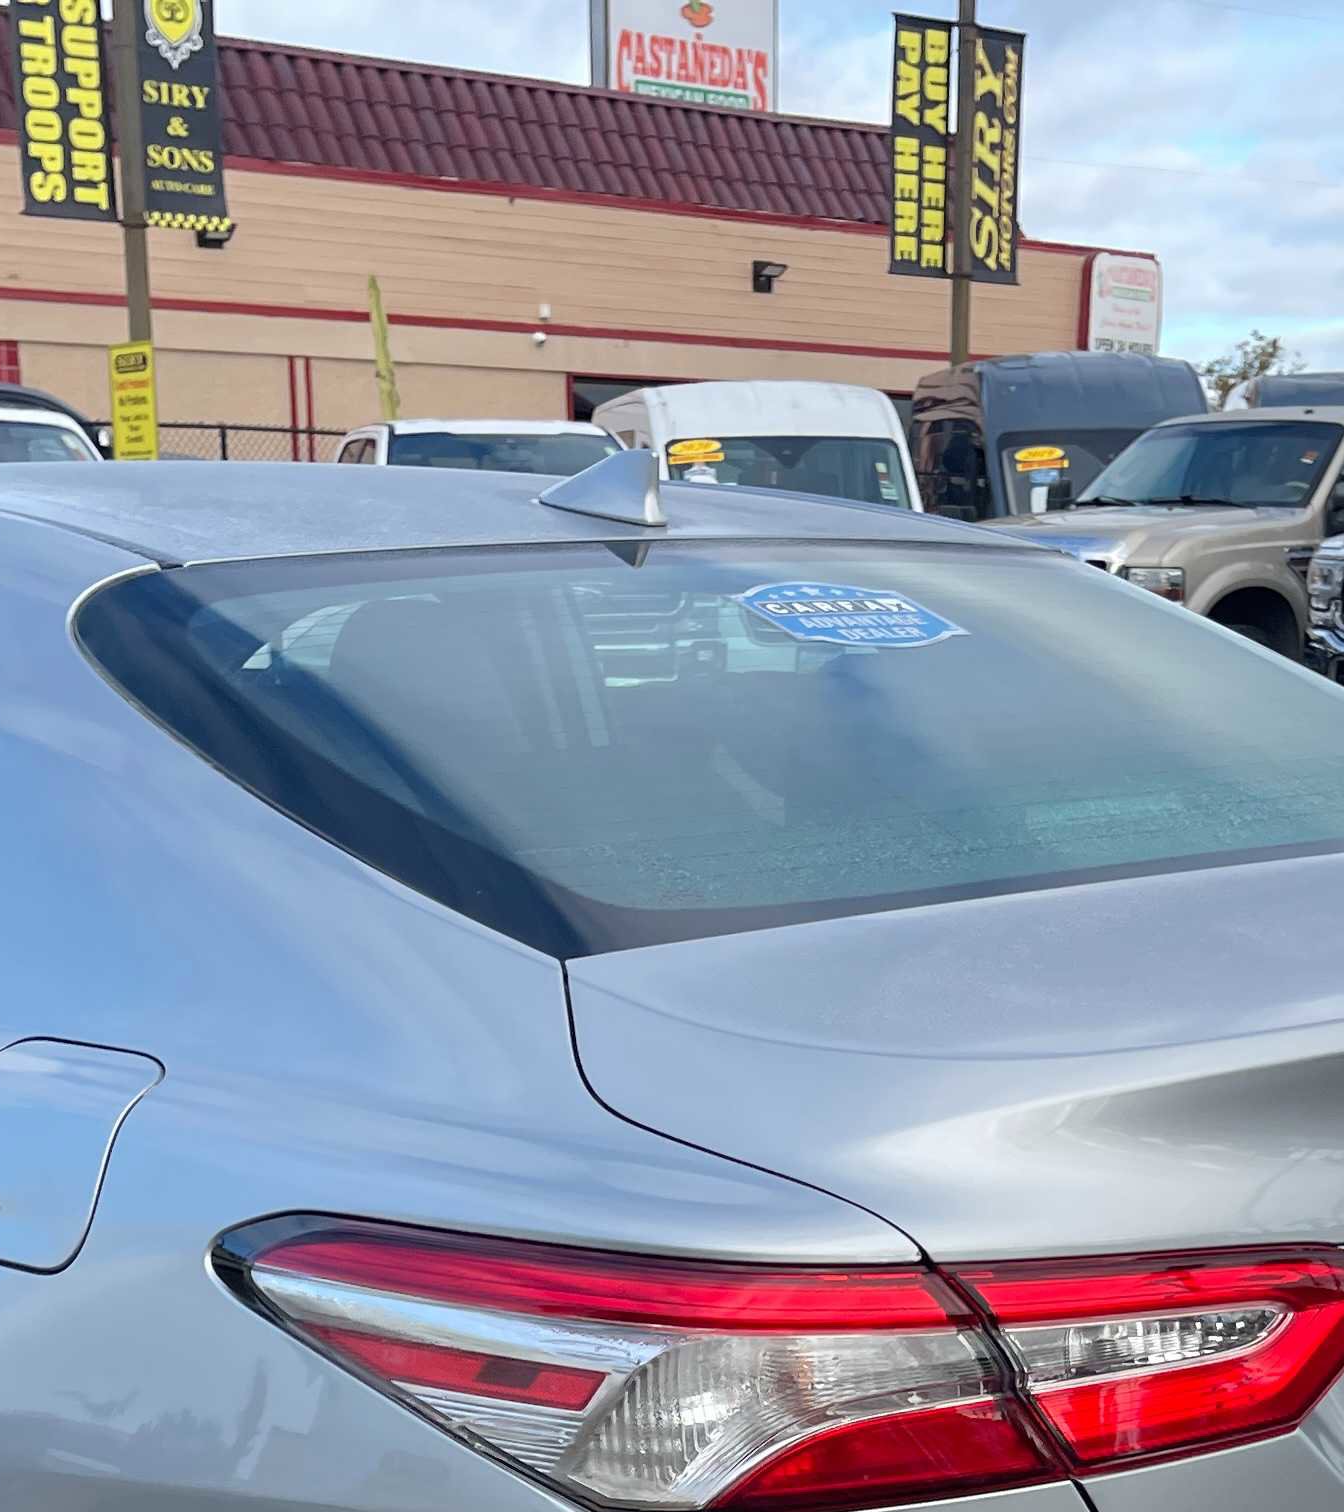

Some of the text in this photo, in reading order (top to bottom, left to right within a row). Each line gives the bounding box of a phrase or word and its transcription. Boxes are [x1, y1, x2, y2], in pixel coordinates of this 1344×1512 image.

[18, 15, 67, 203] TROOPS
[59, 0, 110, 209] SUPPORT
[142, 79, 211, 109] SIRY
[166, 116, 189, 137] &
[146, 143, 215, 174] SONS
[894, 30, 922, 262] PAY HERE
[920, 28, 949, 269] BUY HERE
[969, 37, 1003, 272] SIRY
[765, 598, 918, 615] CARFAX
[799, 614, 929, 630] ADVANTAGE
[837, 626, 928, 641] DEALER
